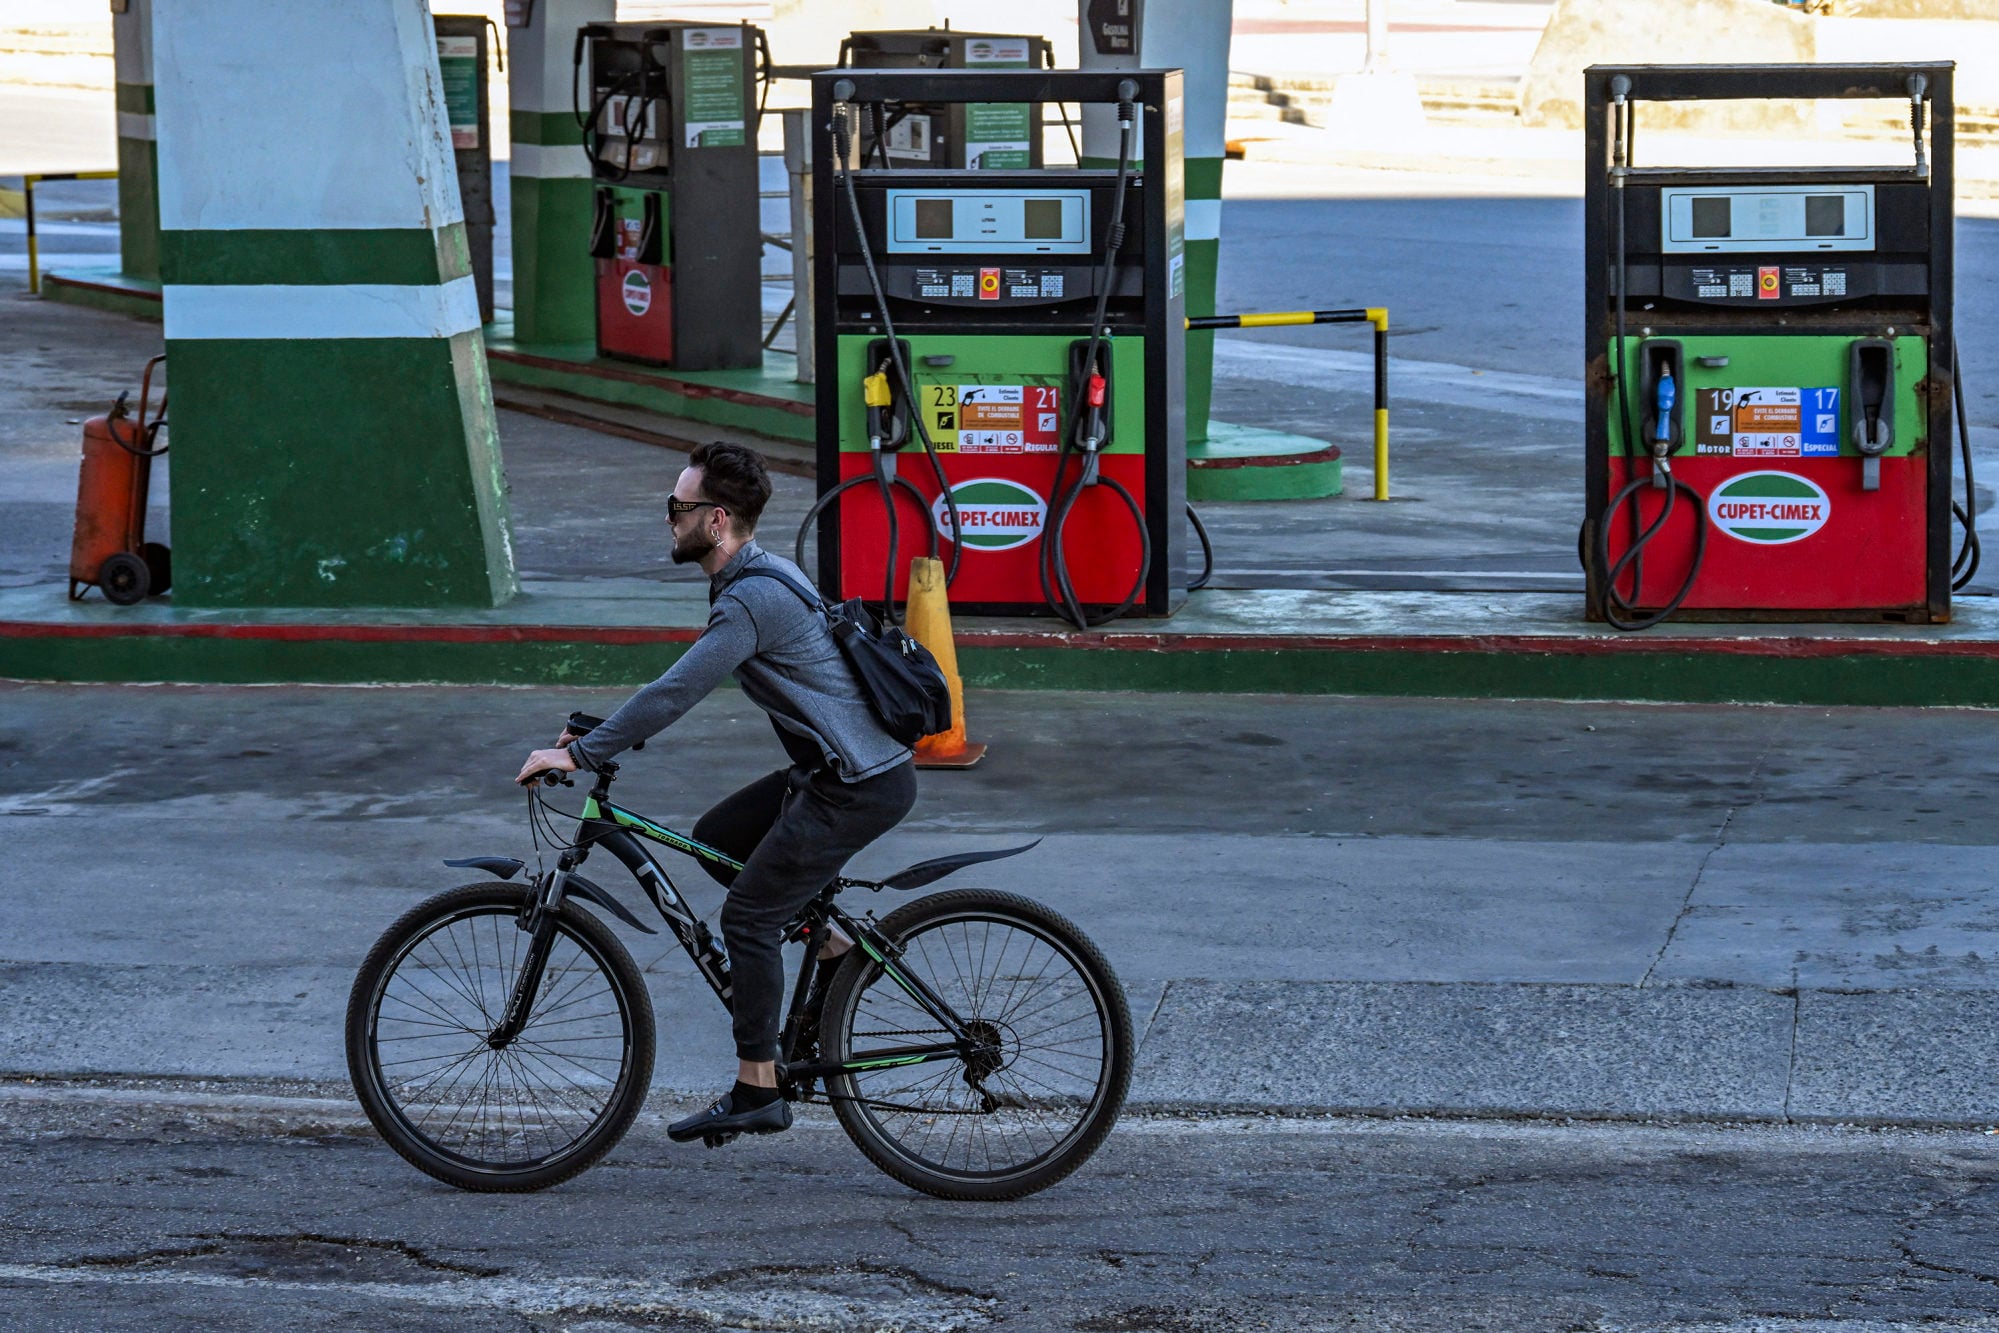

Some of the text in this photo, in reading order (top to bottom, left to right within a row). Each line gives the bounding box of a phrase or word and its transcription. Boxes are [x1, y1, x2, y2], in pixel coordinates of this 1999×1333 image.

[934, 386, 955, 407] 23
[1036, 387, 1056, 409] 21
[1711, 390, 1733, 411] 19
[1815, 388, 1838, 410] 17
[932, 442, 955, 450] IESEL
[1717, 503, 1821, 520] CUPET-CIMEX
